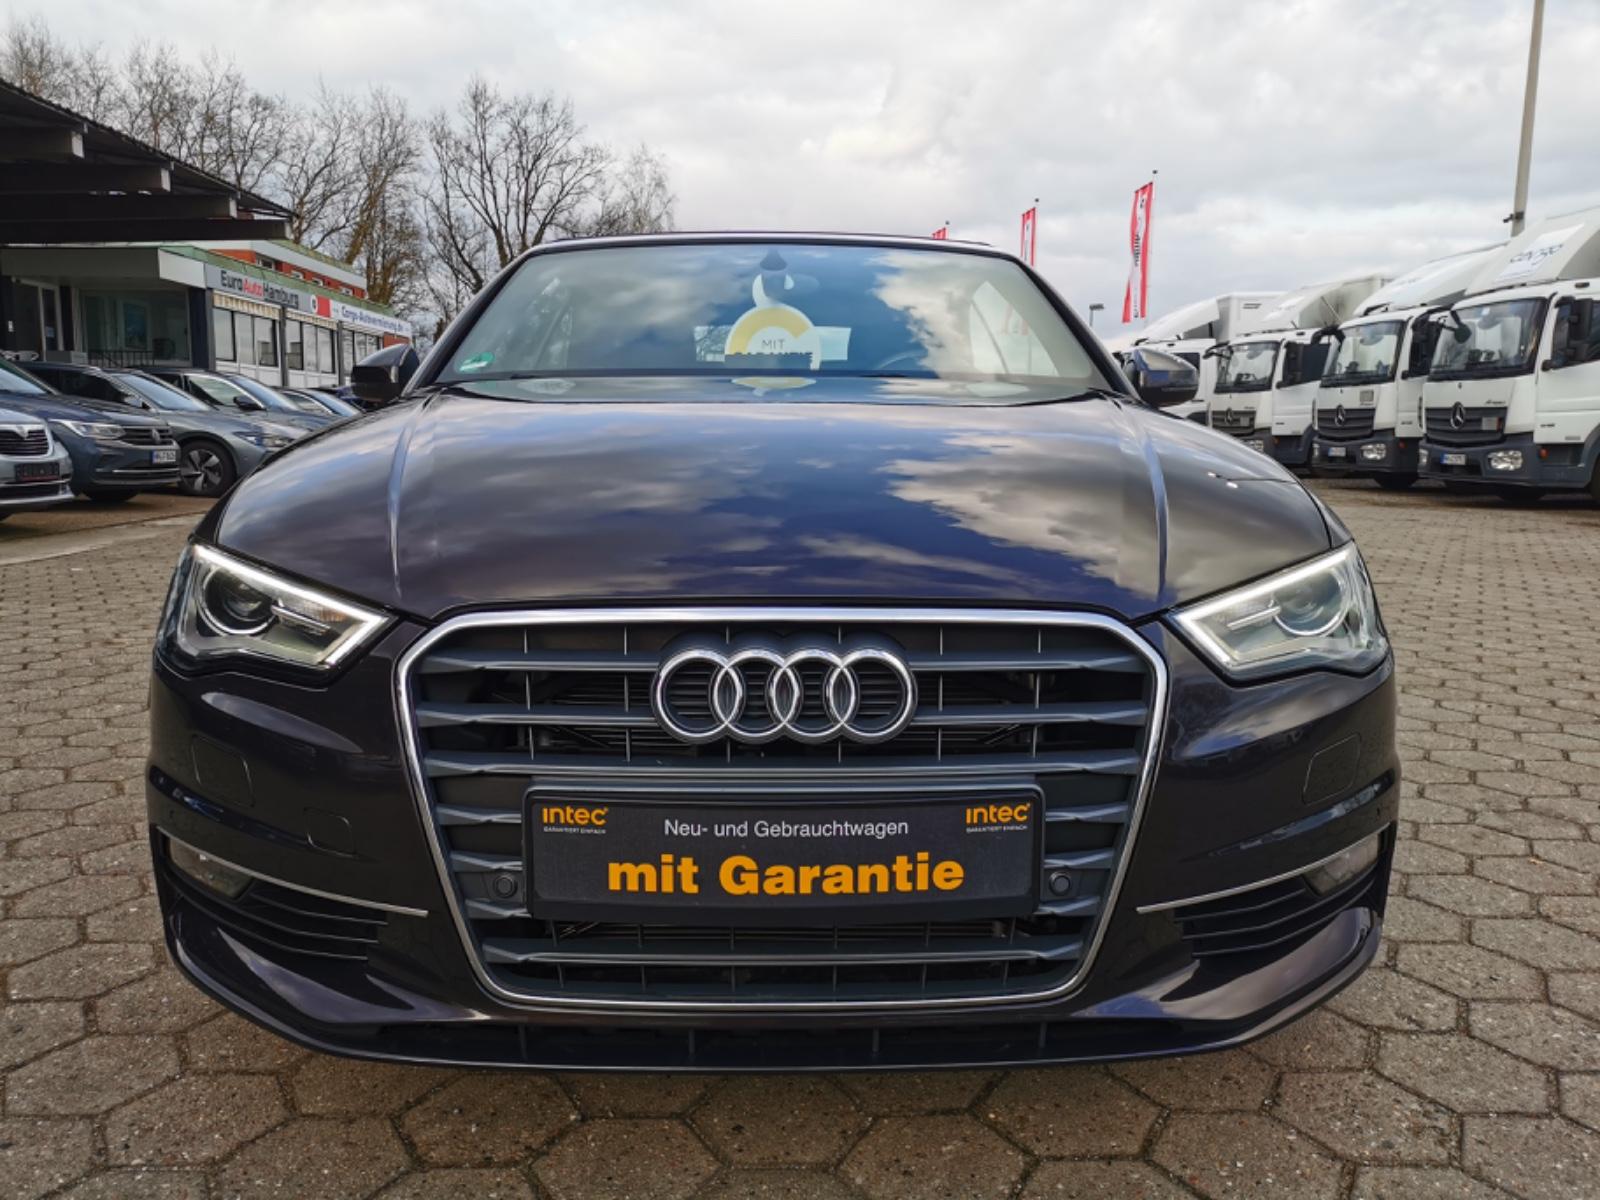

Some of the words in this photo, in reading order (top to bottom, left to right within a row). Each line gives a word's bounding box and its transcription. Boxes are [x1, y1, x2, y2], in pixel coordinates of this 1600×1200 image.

[761, 339, 786, 350] MIT
[543, 805, 608, 826] intec
[966, 803, 1030, 824] intec
[664, 819, 708, 836] Neu-
[714, 821, 748, 837] und
[754, 821, 909, 839] Gebrauchtwagen
[608, 854, 699, 893] mit
[719, 852, 965, 896] Garantie
